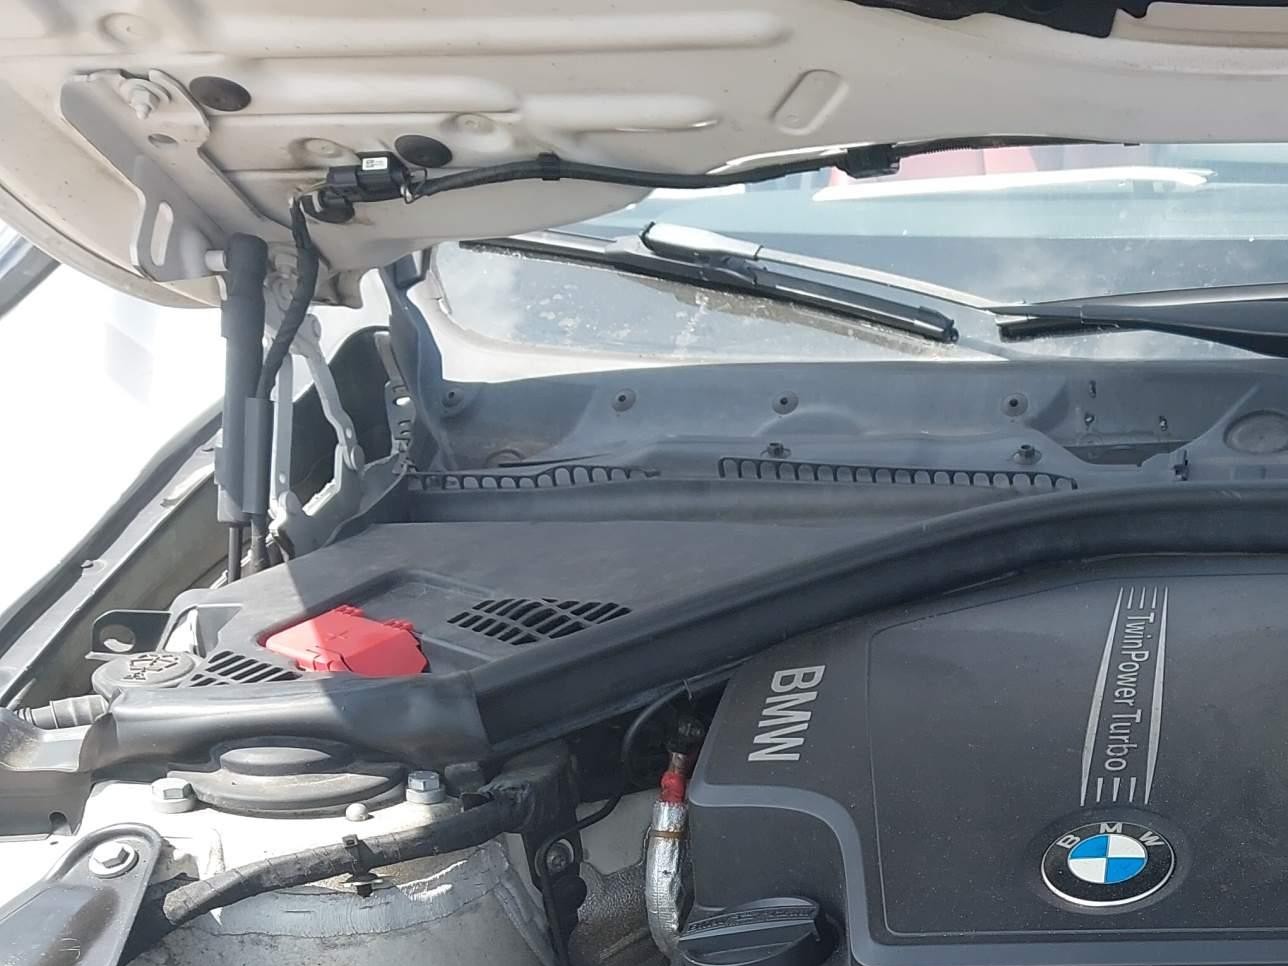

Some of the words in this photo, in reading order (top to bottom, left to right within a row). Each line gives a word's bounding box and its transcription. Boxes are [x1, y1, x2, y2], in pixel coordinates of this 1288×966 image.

[1113, 611, 1155, 707] TwinPower
[747, 664, 826, 762] BMW
[1104, 708, 1143, 771] Turbo
[1056, 821, 1165, 849] BMW
